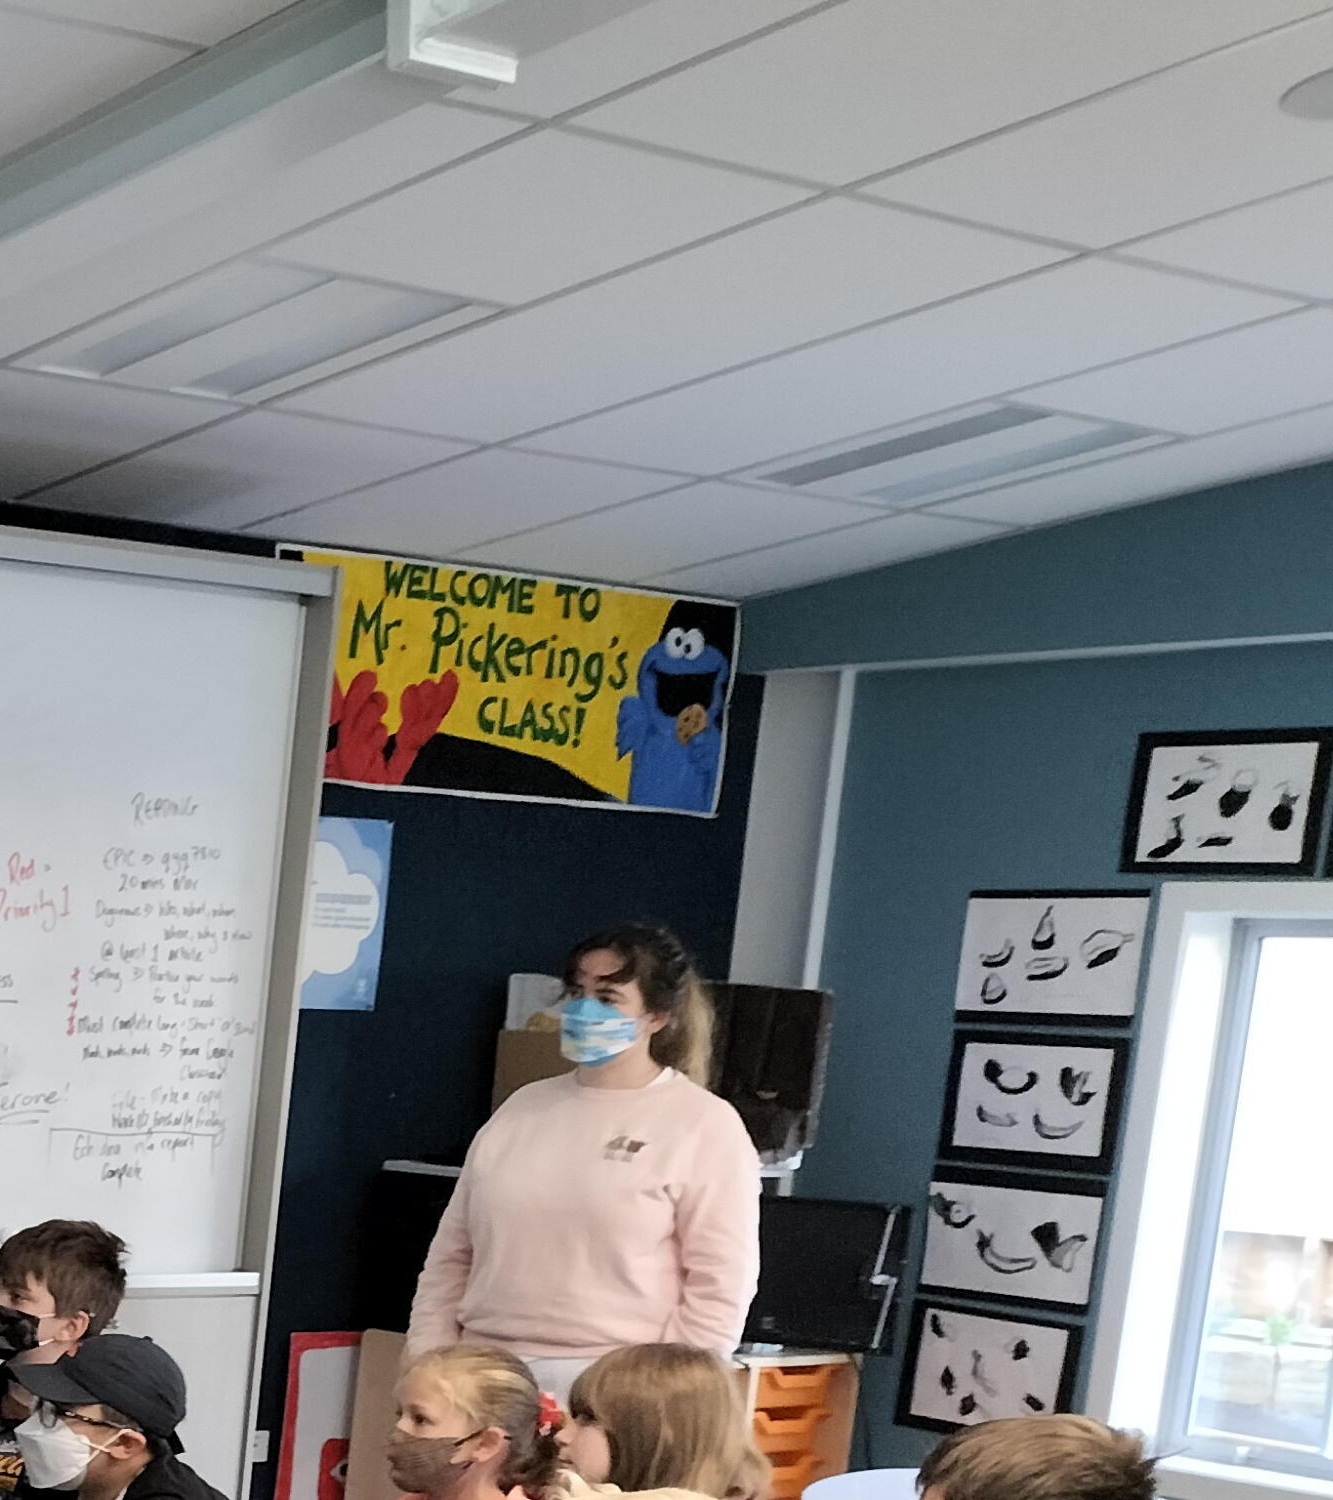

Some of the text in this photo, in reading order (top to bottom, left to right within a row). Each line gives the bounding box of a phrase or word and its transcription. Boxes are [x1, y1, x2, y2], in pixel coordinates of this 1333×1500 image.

[384, 560, 601, 622] WELCOME TO
[348, 599, 628, 703] Mr. Pickering's
[477, 696, 586, 748] CLASS!
[8, 851, 36, 886] Red
